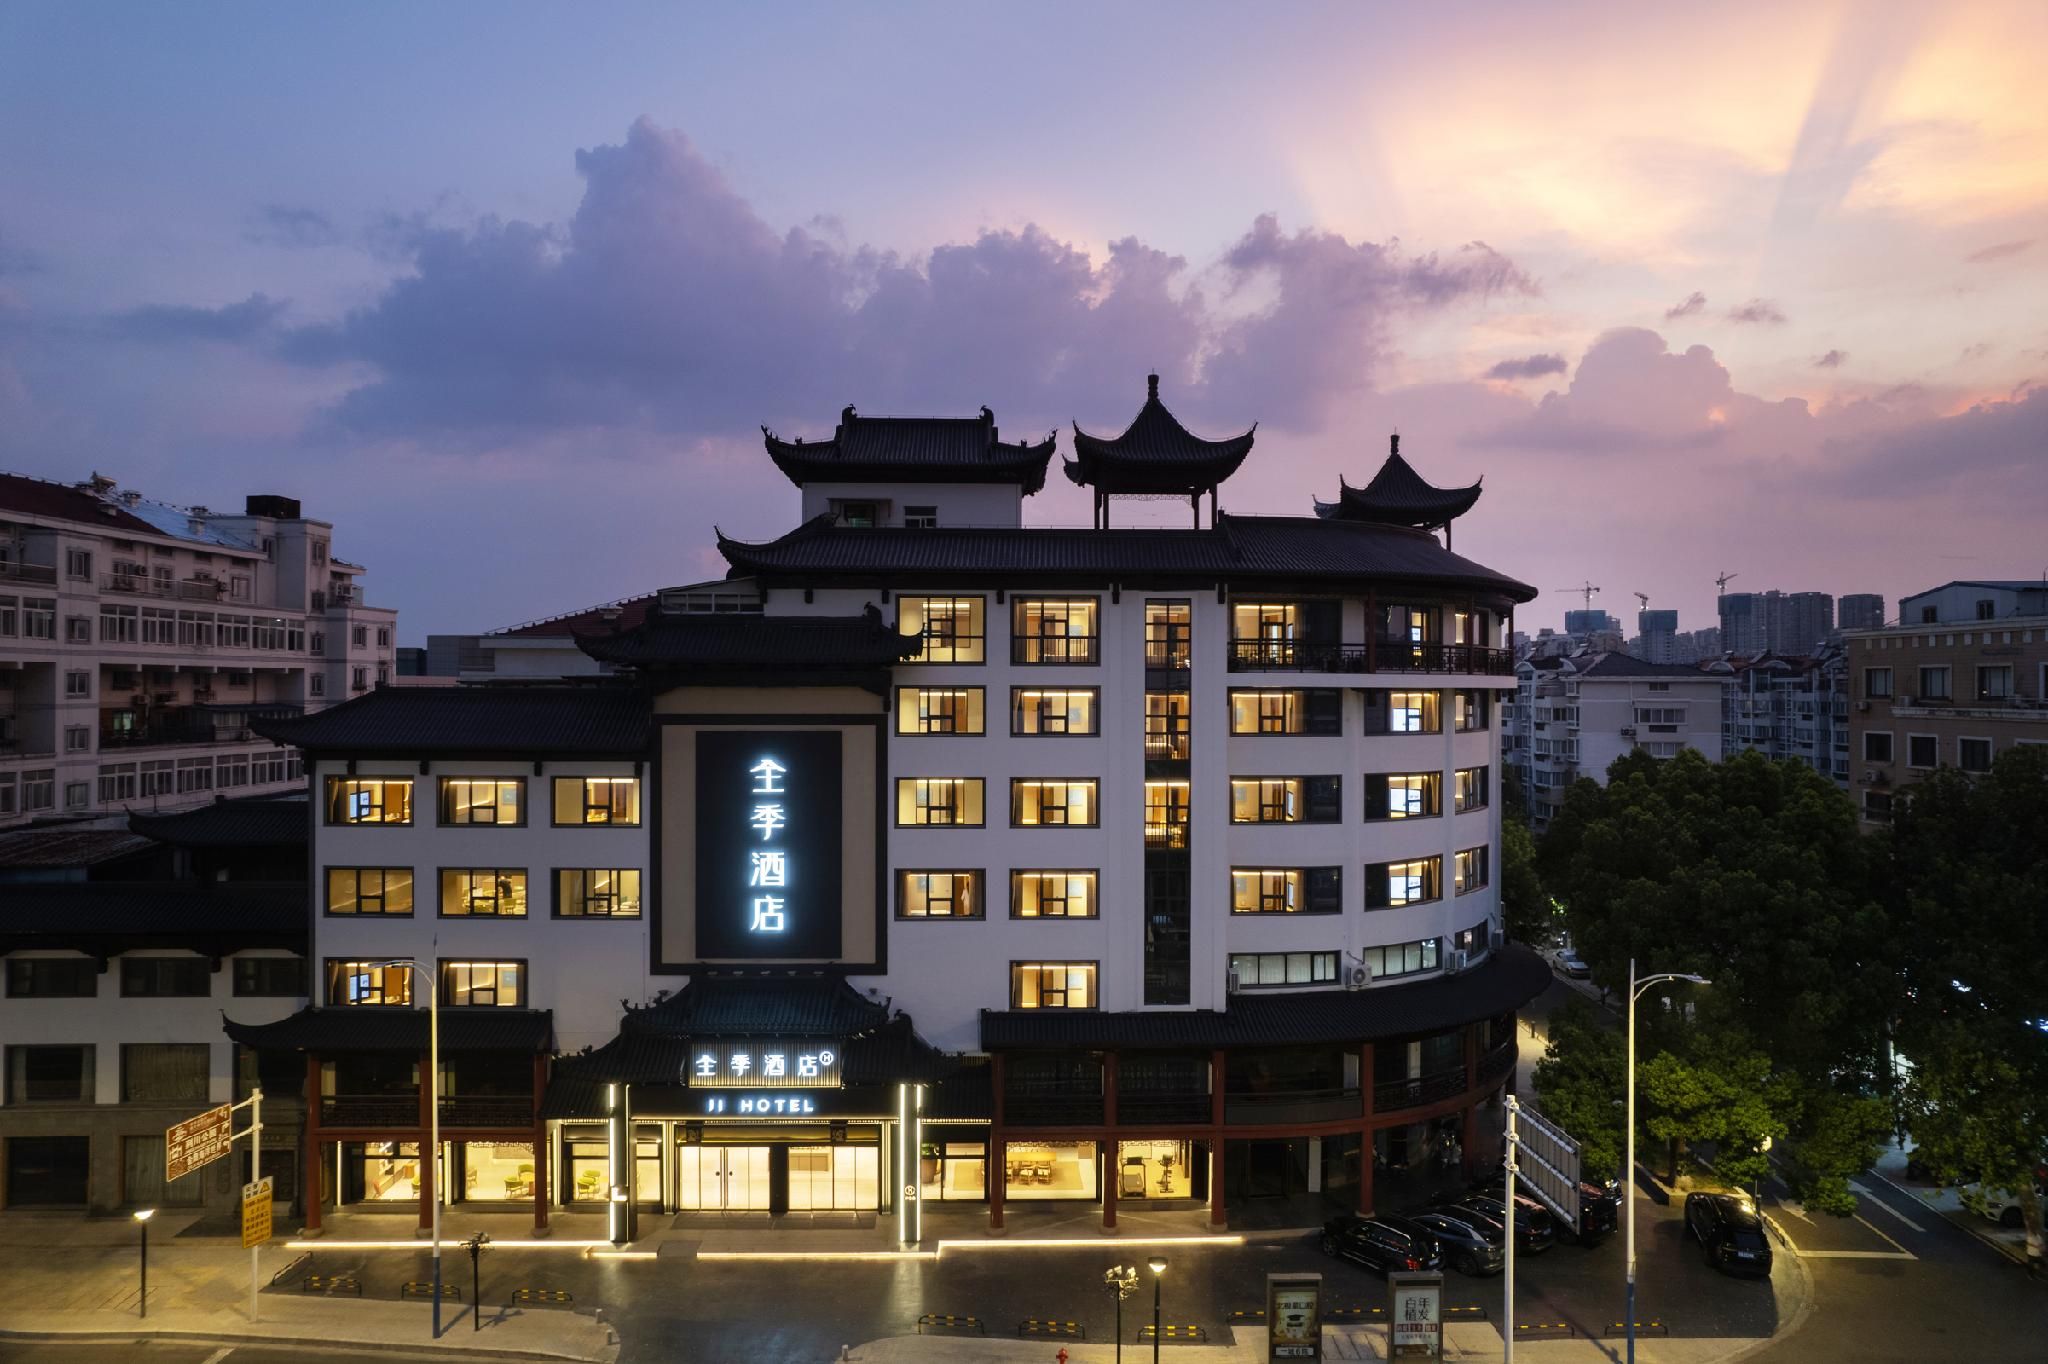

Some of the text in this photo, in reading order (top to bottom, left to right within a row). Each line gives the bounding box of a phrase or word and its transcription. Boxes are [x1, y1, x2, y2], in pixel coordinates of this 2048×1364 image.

[749, 758, 787, 932] 全季酒店
[695, 1053, 818, 1077] 全季酒店
[740, 1099, 814, 1113] HOTEL
